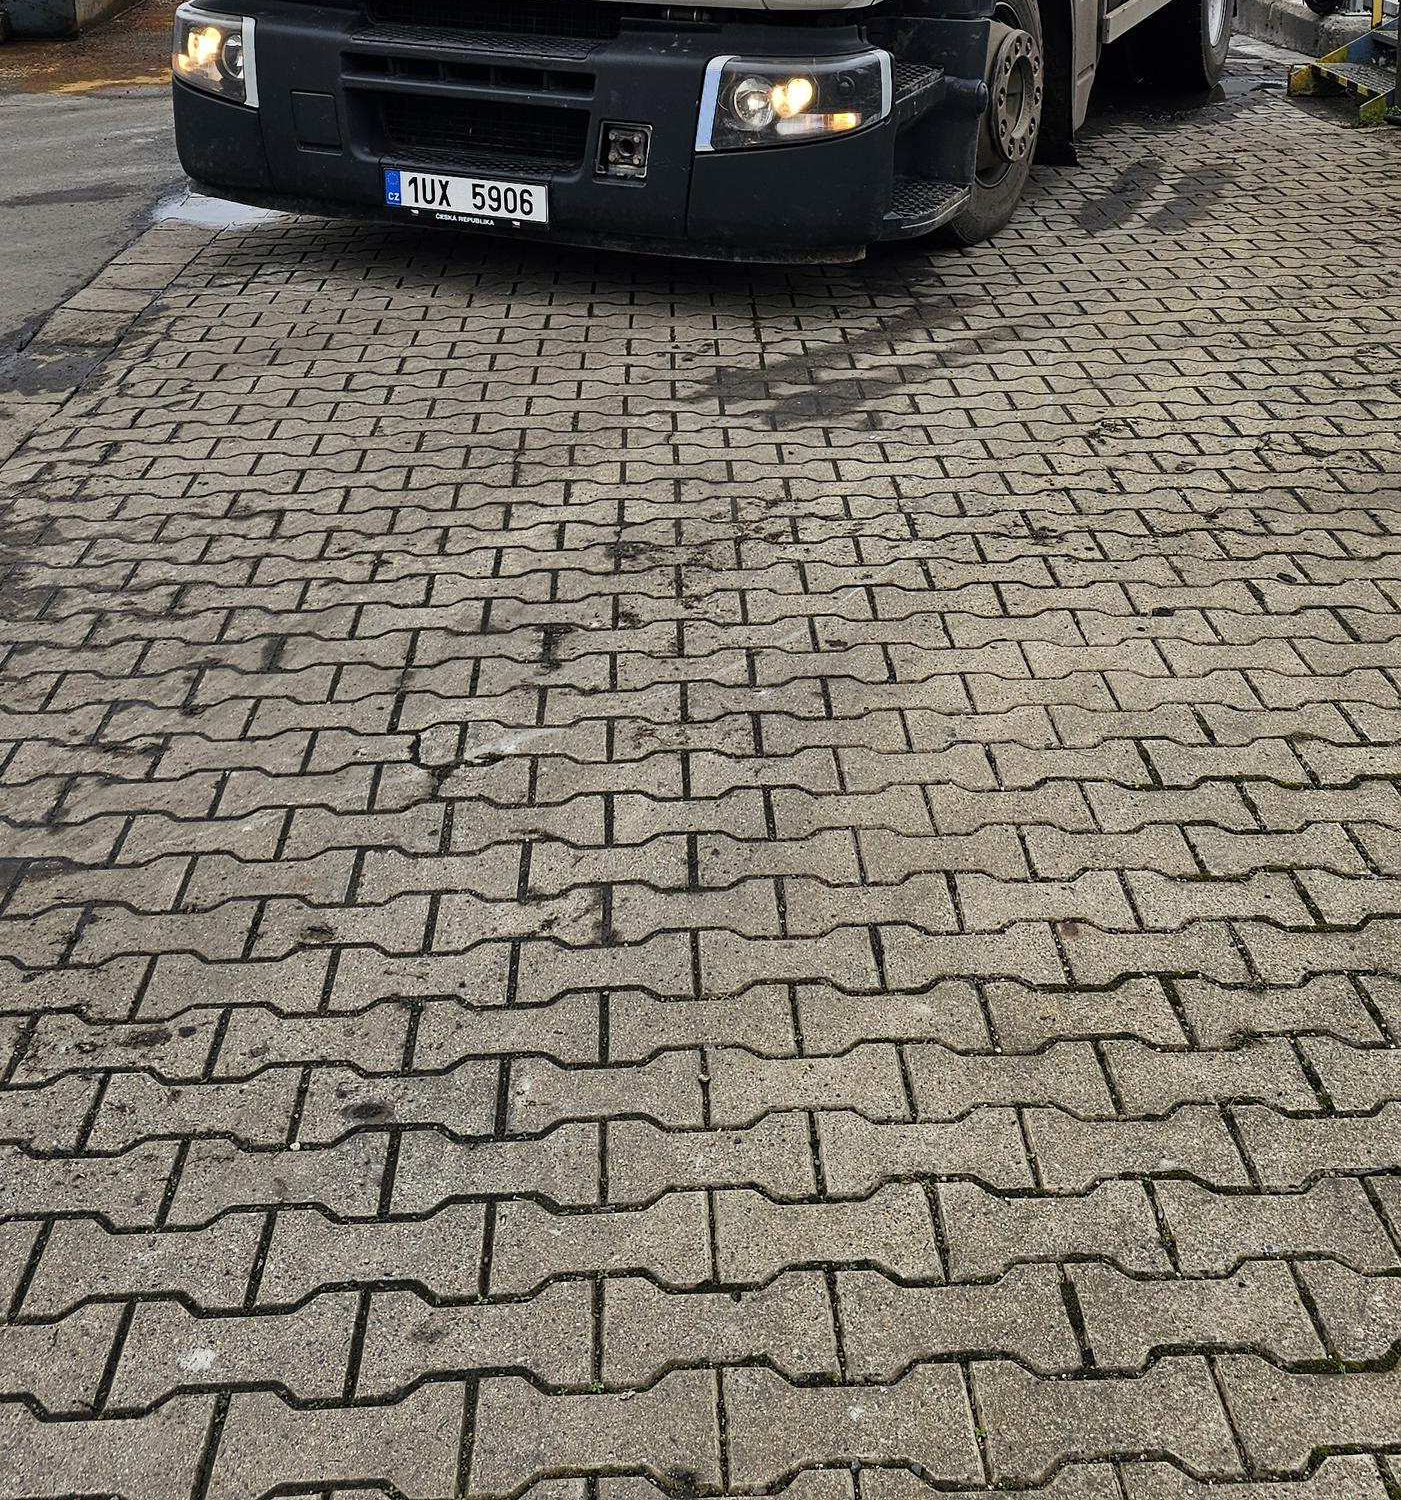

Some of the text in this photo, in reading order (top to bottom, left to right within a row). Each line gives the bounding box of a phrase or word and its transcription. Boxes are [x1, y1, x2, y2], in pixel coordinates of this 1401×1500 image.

[388, 192, 400, 201] CZ
[408, 177, 533, 216] 1UX 5906
[458, 216, 495, 226] REPUBLIKA
